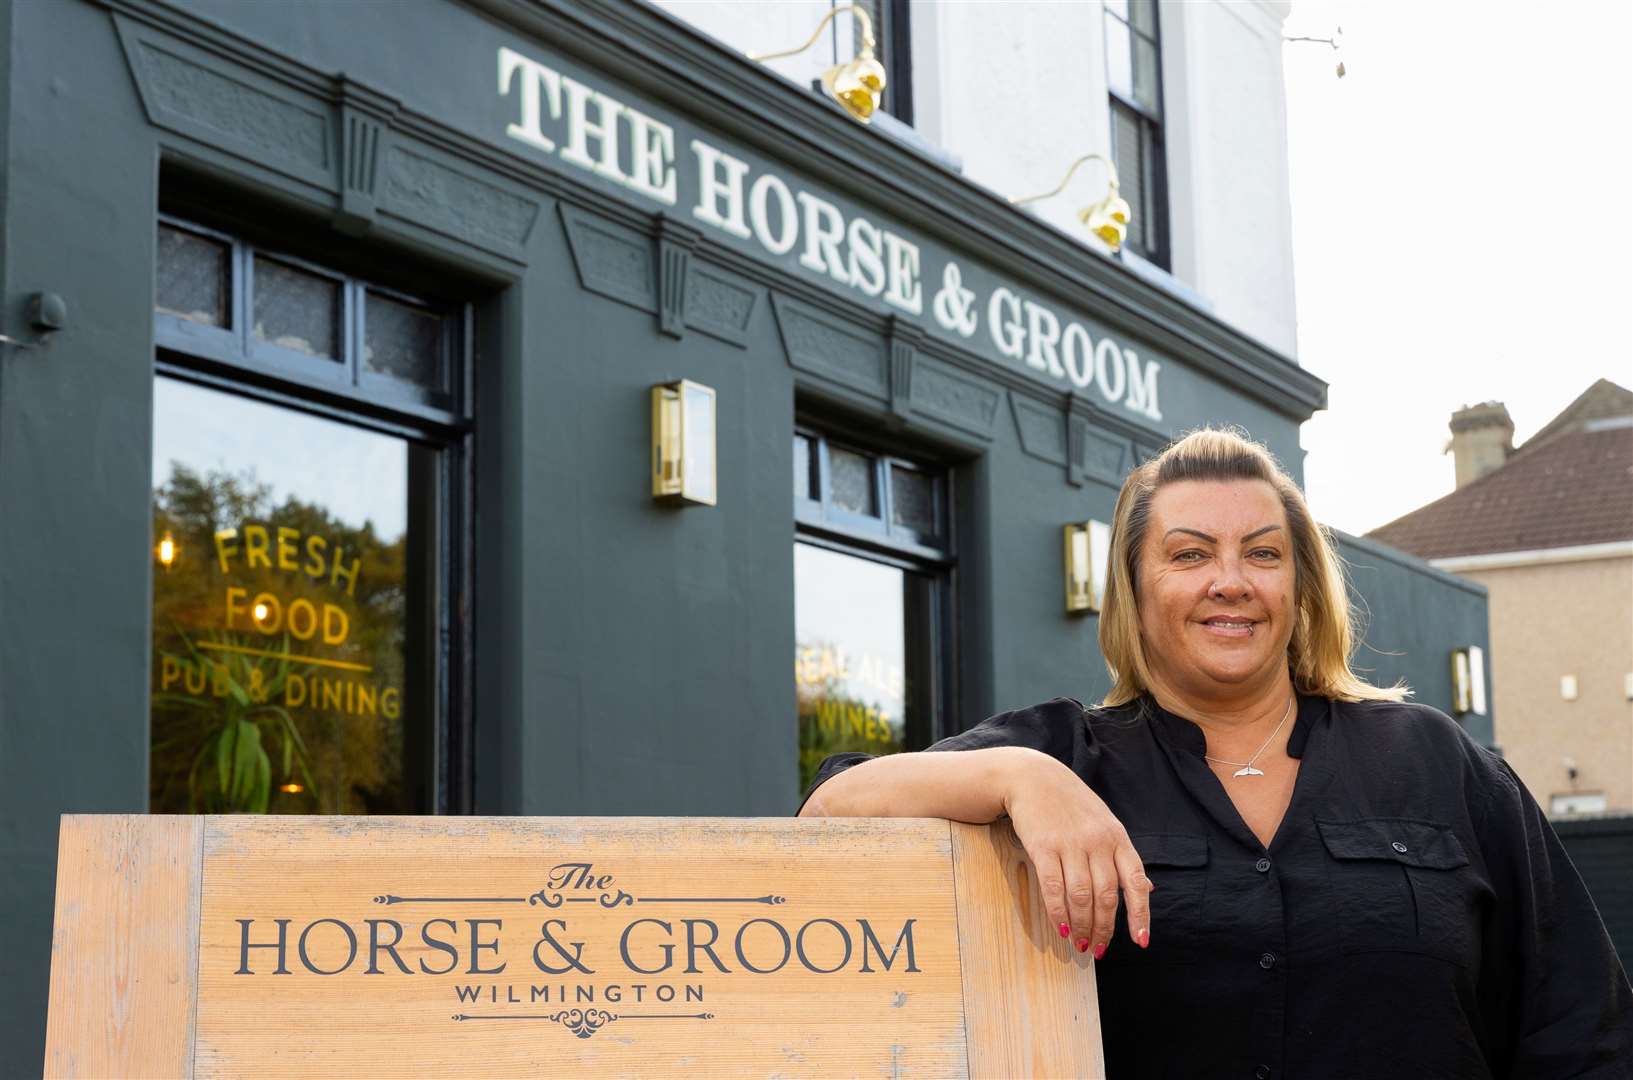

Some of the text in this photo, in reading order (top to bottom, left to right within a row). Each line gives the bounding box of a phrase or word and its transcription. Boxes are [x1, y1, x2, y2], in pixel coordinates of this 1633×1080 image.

[499, 47, 1163, 421] THE HORSE & GROOM
[214, 525, 361, 597] FRESH
[225, 586, 349, 646] FOOD
[161, 656, 400, 720] PUB & DINING
[816, 697, 892, 744] WINES
[547, 862, 615, 891] The
[233, 916, 923, 976] HORSE & GROOM
[454, 984, 705, 1004] WILMINGTON
